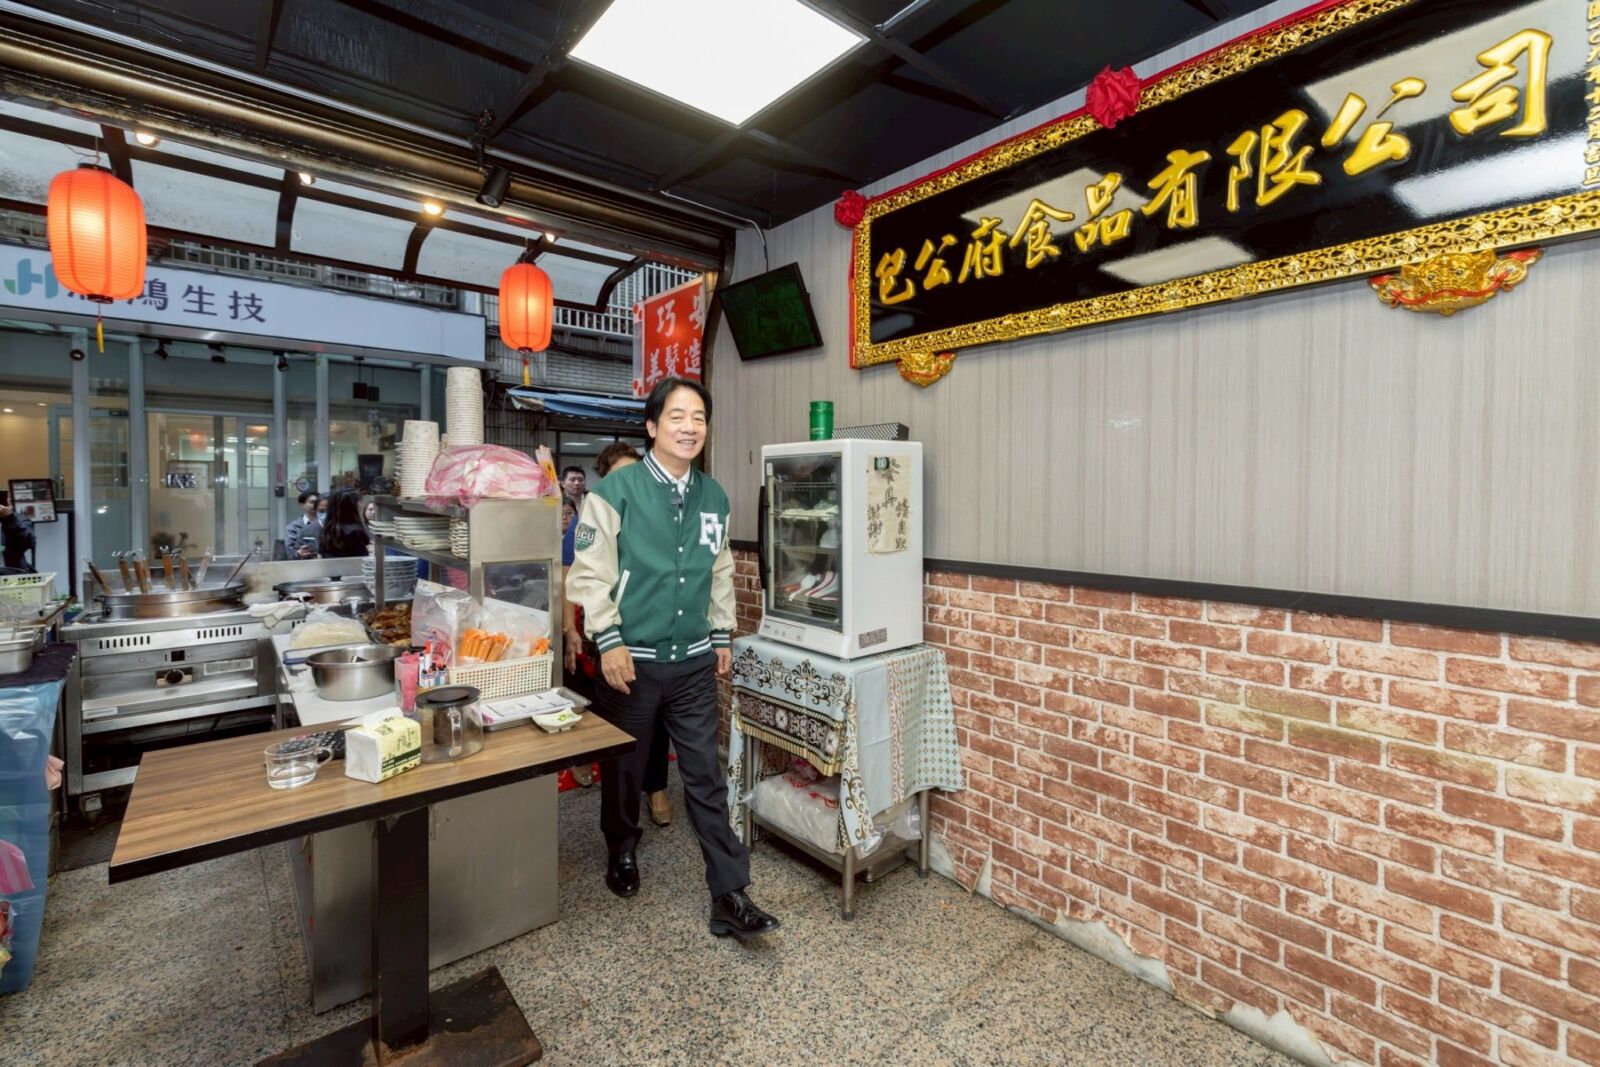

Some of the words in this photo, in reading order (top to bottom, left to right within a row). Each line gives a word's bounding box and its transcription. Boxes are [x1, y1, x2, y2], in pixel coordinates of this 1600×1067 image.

[874, 27, 1553, 305] 包公府食品有限公司
[67, 277, 267, 323] 鴻生技
